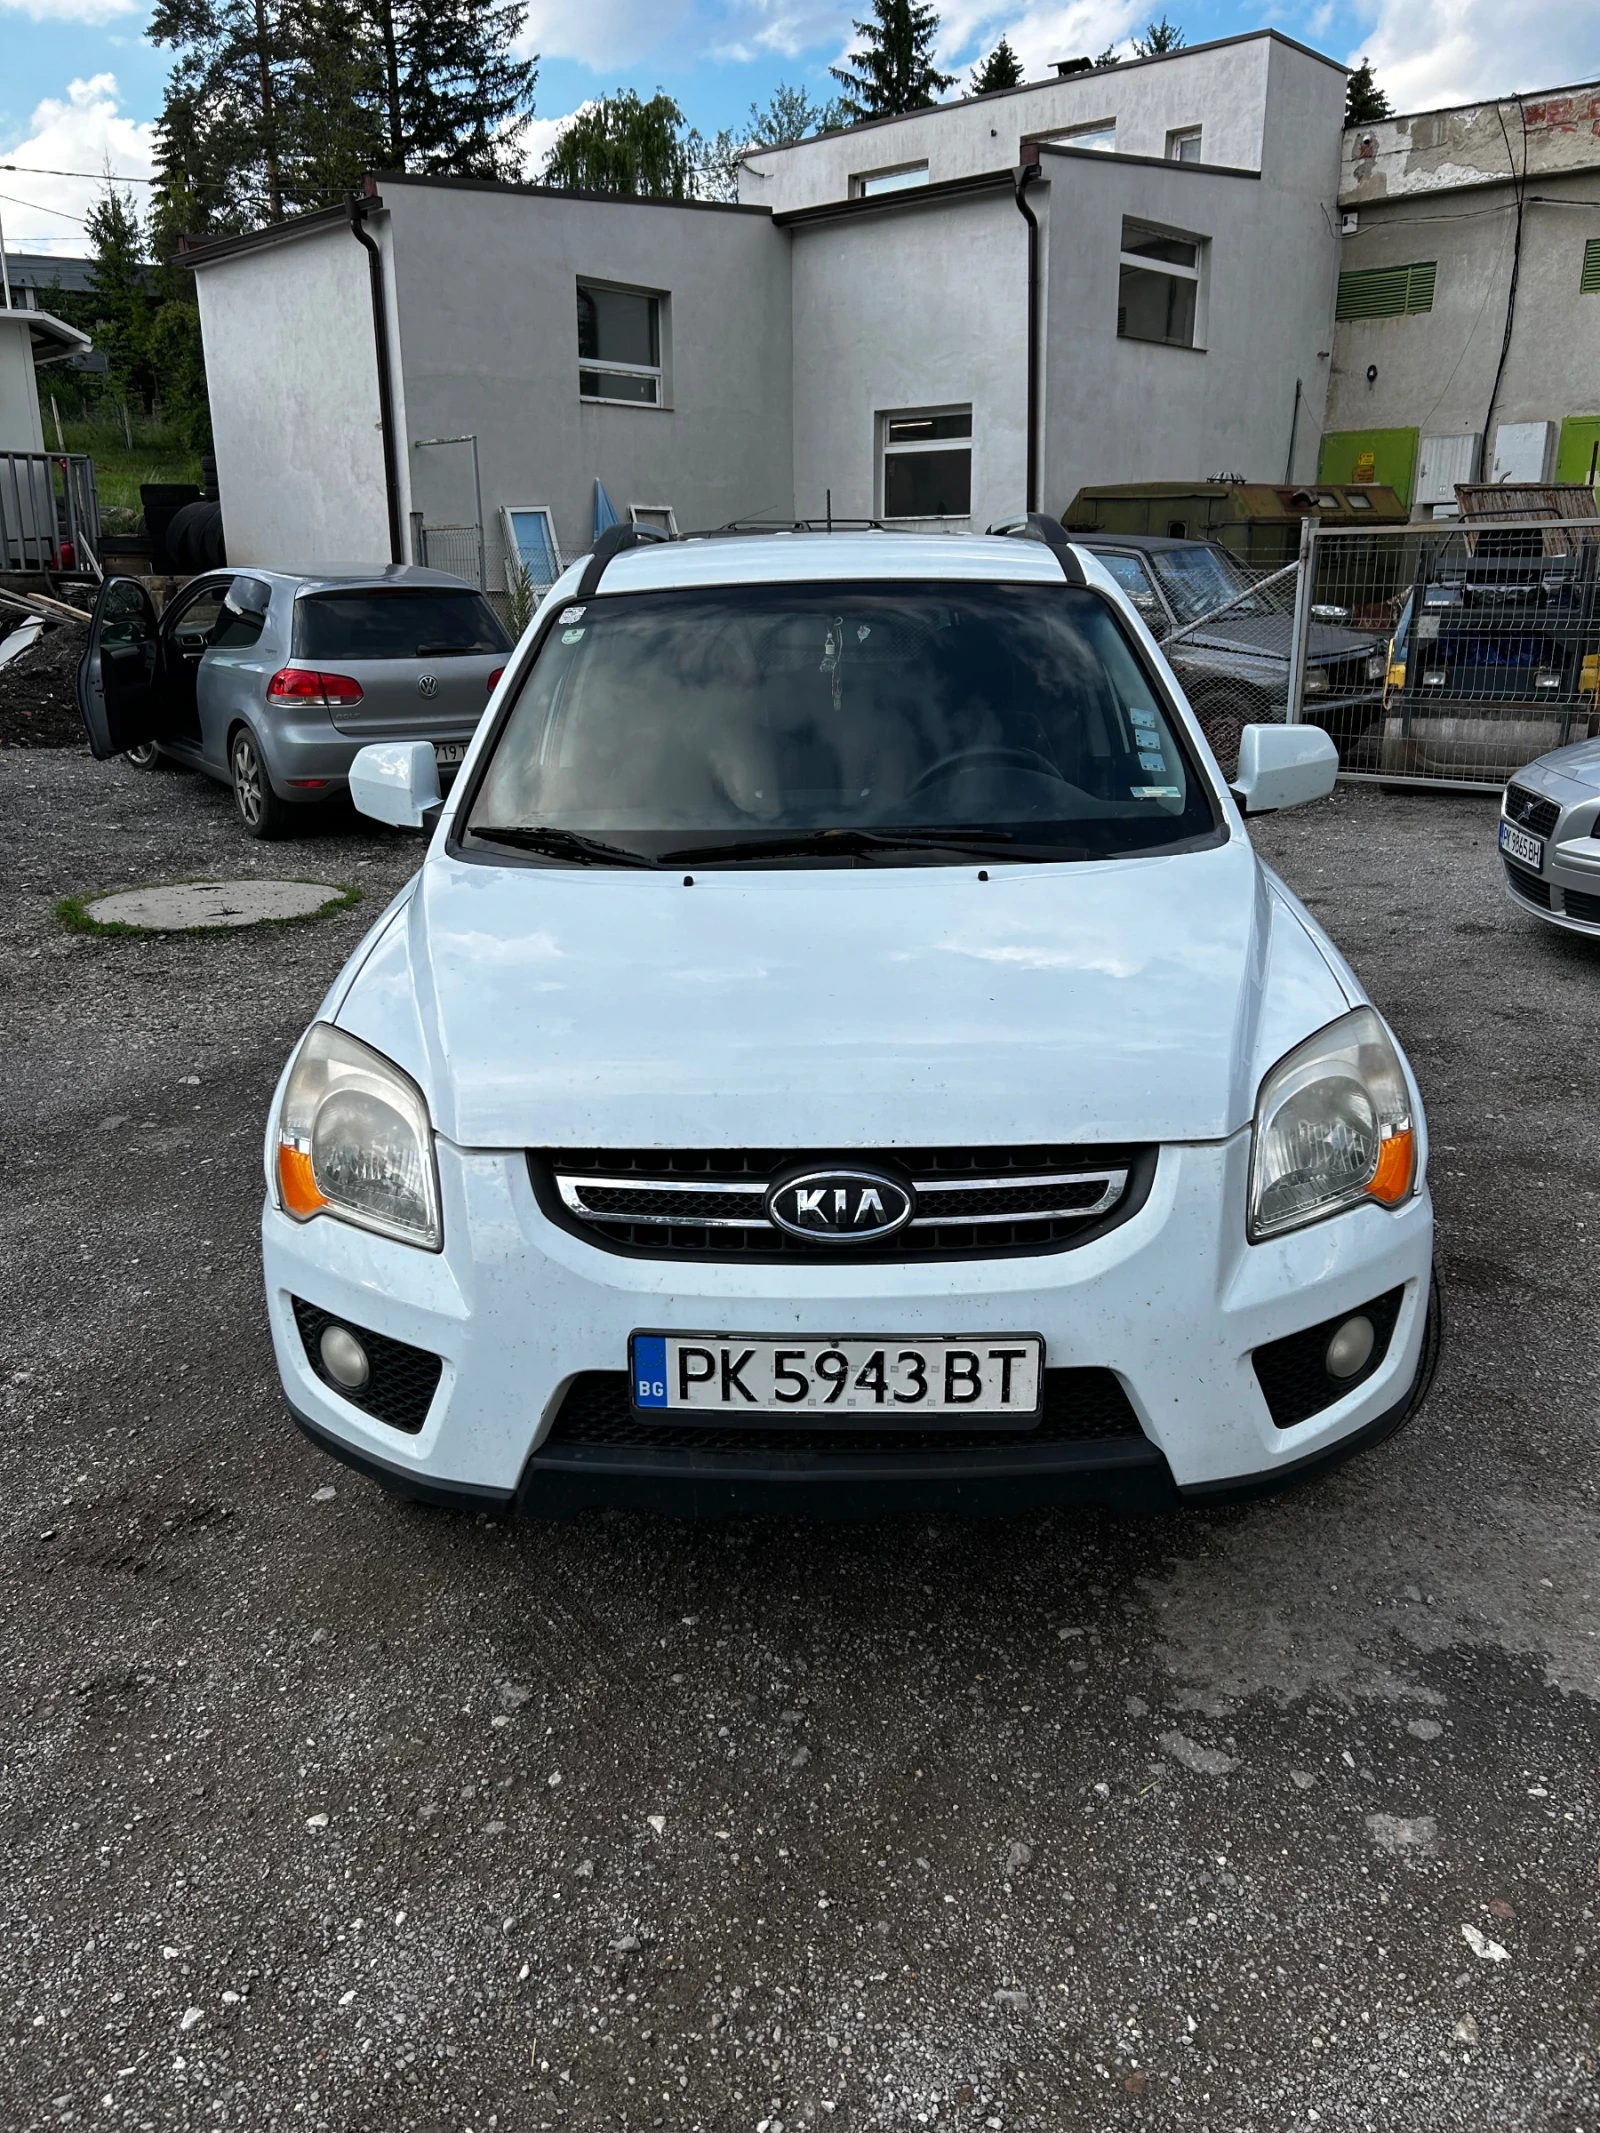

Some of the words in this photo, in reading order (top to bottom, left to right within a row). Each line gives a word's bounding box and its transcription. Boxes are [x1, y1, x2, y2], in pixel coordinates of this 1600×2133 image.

[335, 712, 361, 720] GOLF
[459, 743, 470, 758] T
[1528, 841, 1540, 866] BH
[795, 1188, 888, 1223] KIA
[676, 1346, 758, 1402] PK
[773, 1349, 927, 1404] 5943
[944, 1349, 1027, 1404] BT
[639, 1381, 664, 1397] BG
